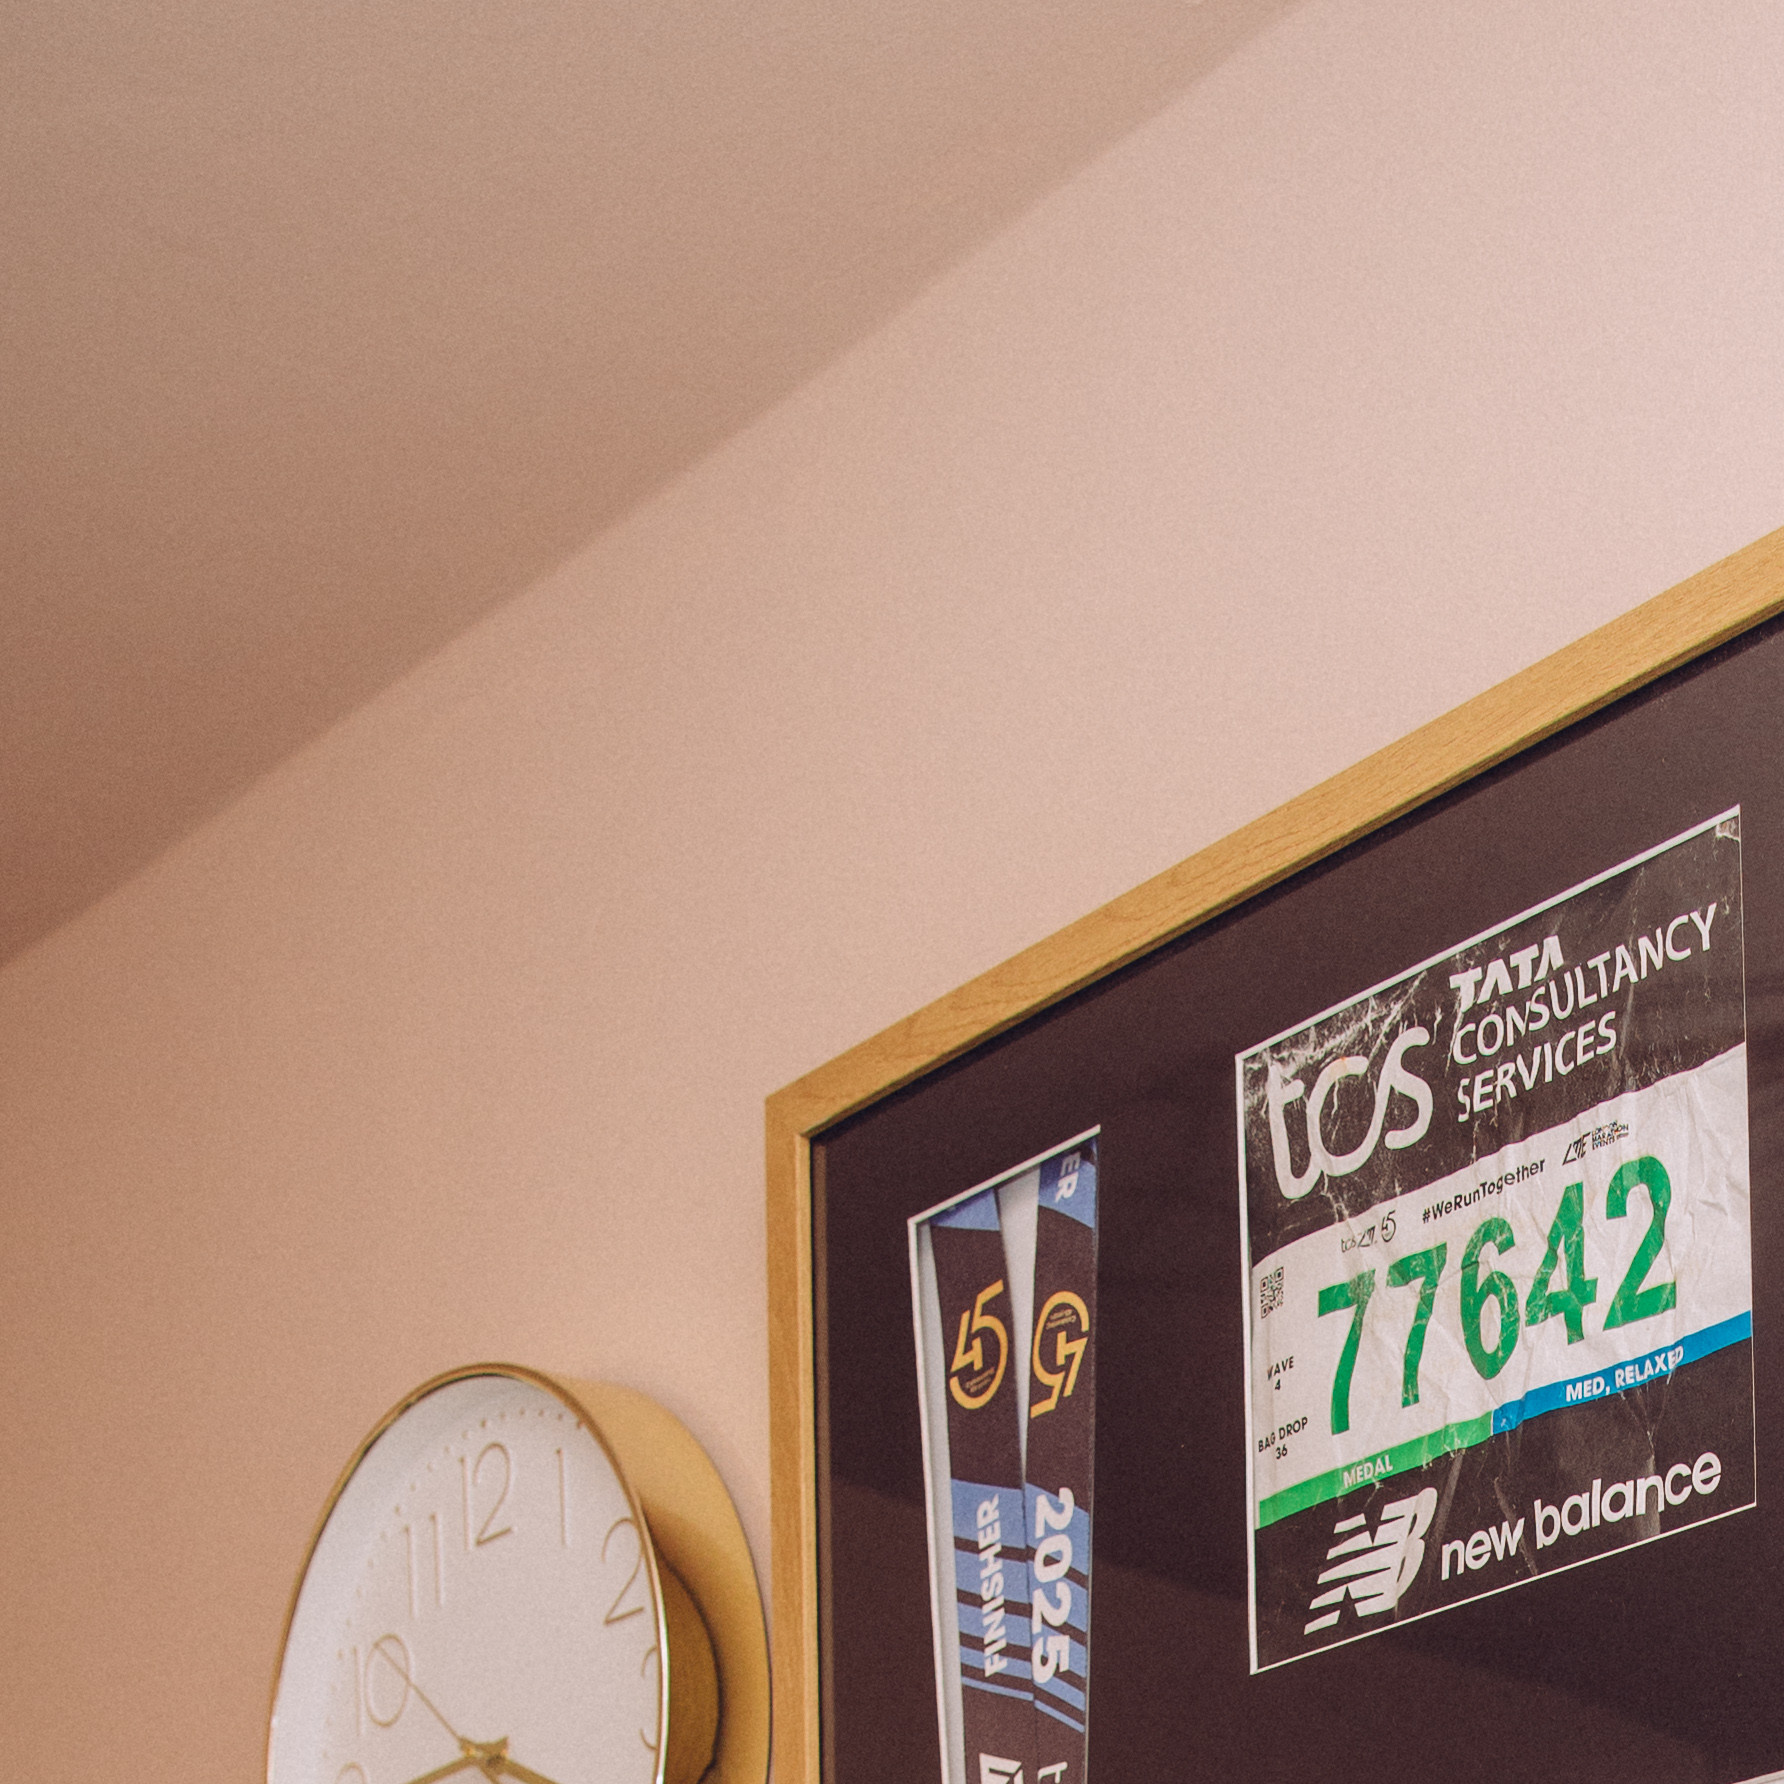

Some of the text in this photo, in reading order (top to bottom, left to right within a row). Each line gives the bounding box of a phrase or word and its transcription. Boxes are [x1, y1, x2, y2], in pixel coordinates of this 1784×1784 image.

[1450, 935, 1564, 1012] TATA
[1451, 903, 1717, 1065] CONSULTANCY
[1268, 1026, 1434, 1200] tcs
[1458, 1010, 1617, 1122] SERVICES
[1422, 1158, 1546, 1224] #WeRunTogether
[1317, 1154, 1677, 1436] 77642
[1274, 1379, 1281, 1391] 4
[1566, 1345, 1685, 1402] MED, RELAXED
[1258, 1416, 1308, 1453] BAG DROP
[1275, 1444, 1288, 1460] 36
[1343, 1454, 1394, 1488] MEDAL
[460, 1441, 513, 1549] 12
[556, 1448, 569, 1547] 1
[1441, 1450, 1723, 1580] new balance
[403, 1512, 443, 1619] 11
[601, 1516, 646, 1626] 2
[975, 1492, 1008, 1678] FINISHER
[1031, 1486, 1075, 1685] 2025
[352, 1633, 411, 1737] 10
